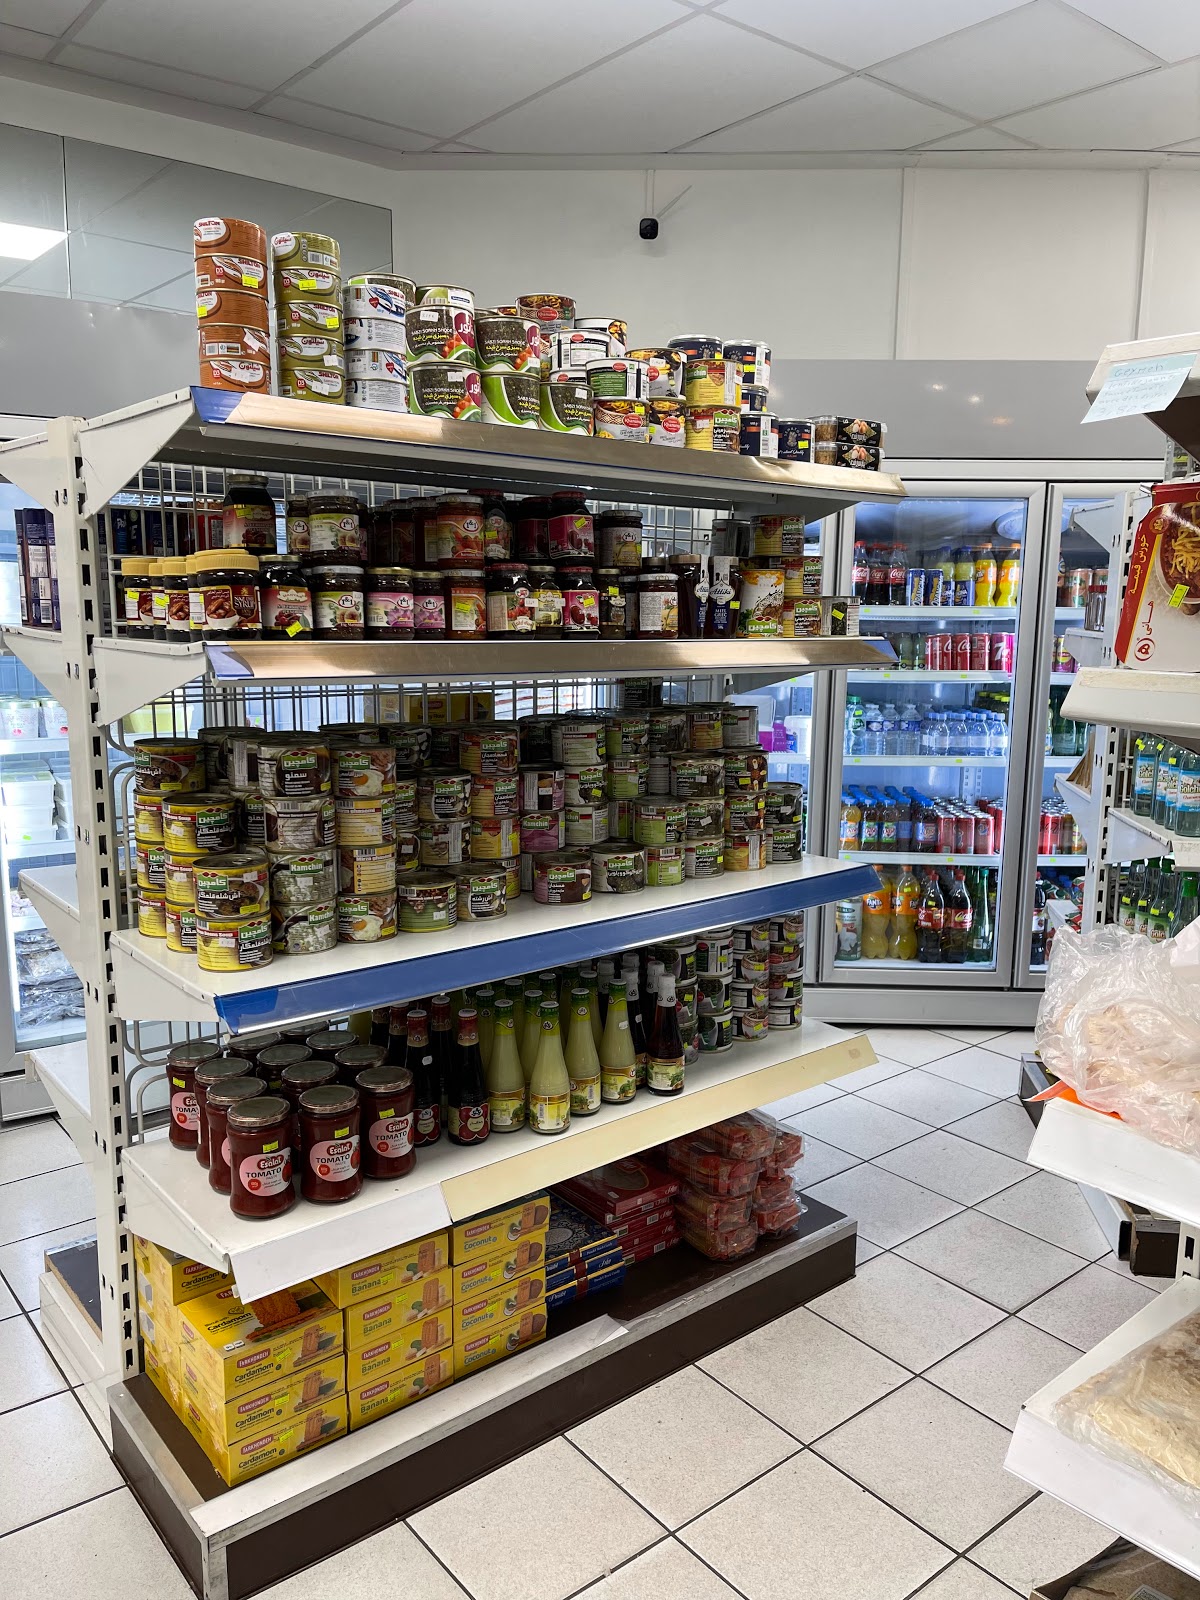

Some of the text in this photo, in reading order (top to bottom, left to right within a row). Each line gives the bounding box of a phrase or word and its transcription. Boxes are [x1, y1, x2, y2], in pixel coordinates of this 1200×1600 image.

[342, 518, 355, 528] 1&1
[465, 519, 478, 529] 1&1
[340, 595, 354, 605] 1&1
[748, 621, 777, 633] کامچین
[284, 756, 316, 768] کامچین
[340, 759, 369, 768] کامچین
[198, 812, 229, 824] کامچین
[290, 863, 323, 872] Kamchin
[198, 878, 227, 889] کامچین
[340, 905, 368, 914] کامچین
[240, 925, 268, 938] کامچین
[375, 1131, 408, 1141] TOMATO
[329, 1142, 351, 1154] Esalat
[260, 1156, 283, 1169] Esalat
[316, 1153, 350, 1164] TOMATO
[245, 1166, 282, 1179] TOMATO
[463, 1235, 491, 1250] Coconut
[181, 1271, 220, 1287] Cardamom
[460, 1275, 489, 1292] Coconut
[351, 1279, 381, 1294] Banana
[207, 1312, 252, 1331] Cardamom
[363, 1317, 392, 1334] Banana
[461, 1313, 489, 1329] Coconut
[239, 1350, 270, 1368] FARKHONDEH
[464, 1348, 491, 1364] Coconut
[361, 1356, 391, 1374] Banana
[234, 1362, 274, 1382] Cardamom
[360, 1396, 389, 1414] Banana
[235, 1407, 275, 1428] Cardamom
[242, 1436, 273, 1454] FARKHONDEH
[238, 1447, 277, 1468] Cardamom
